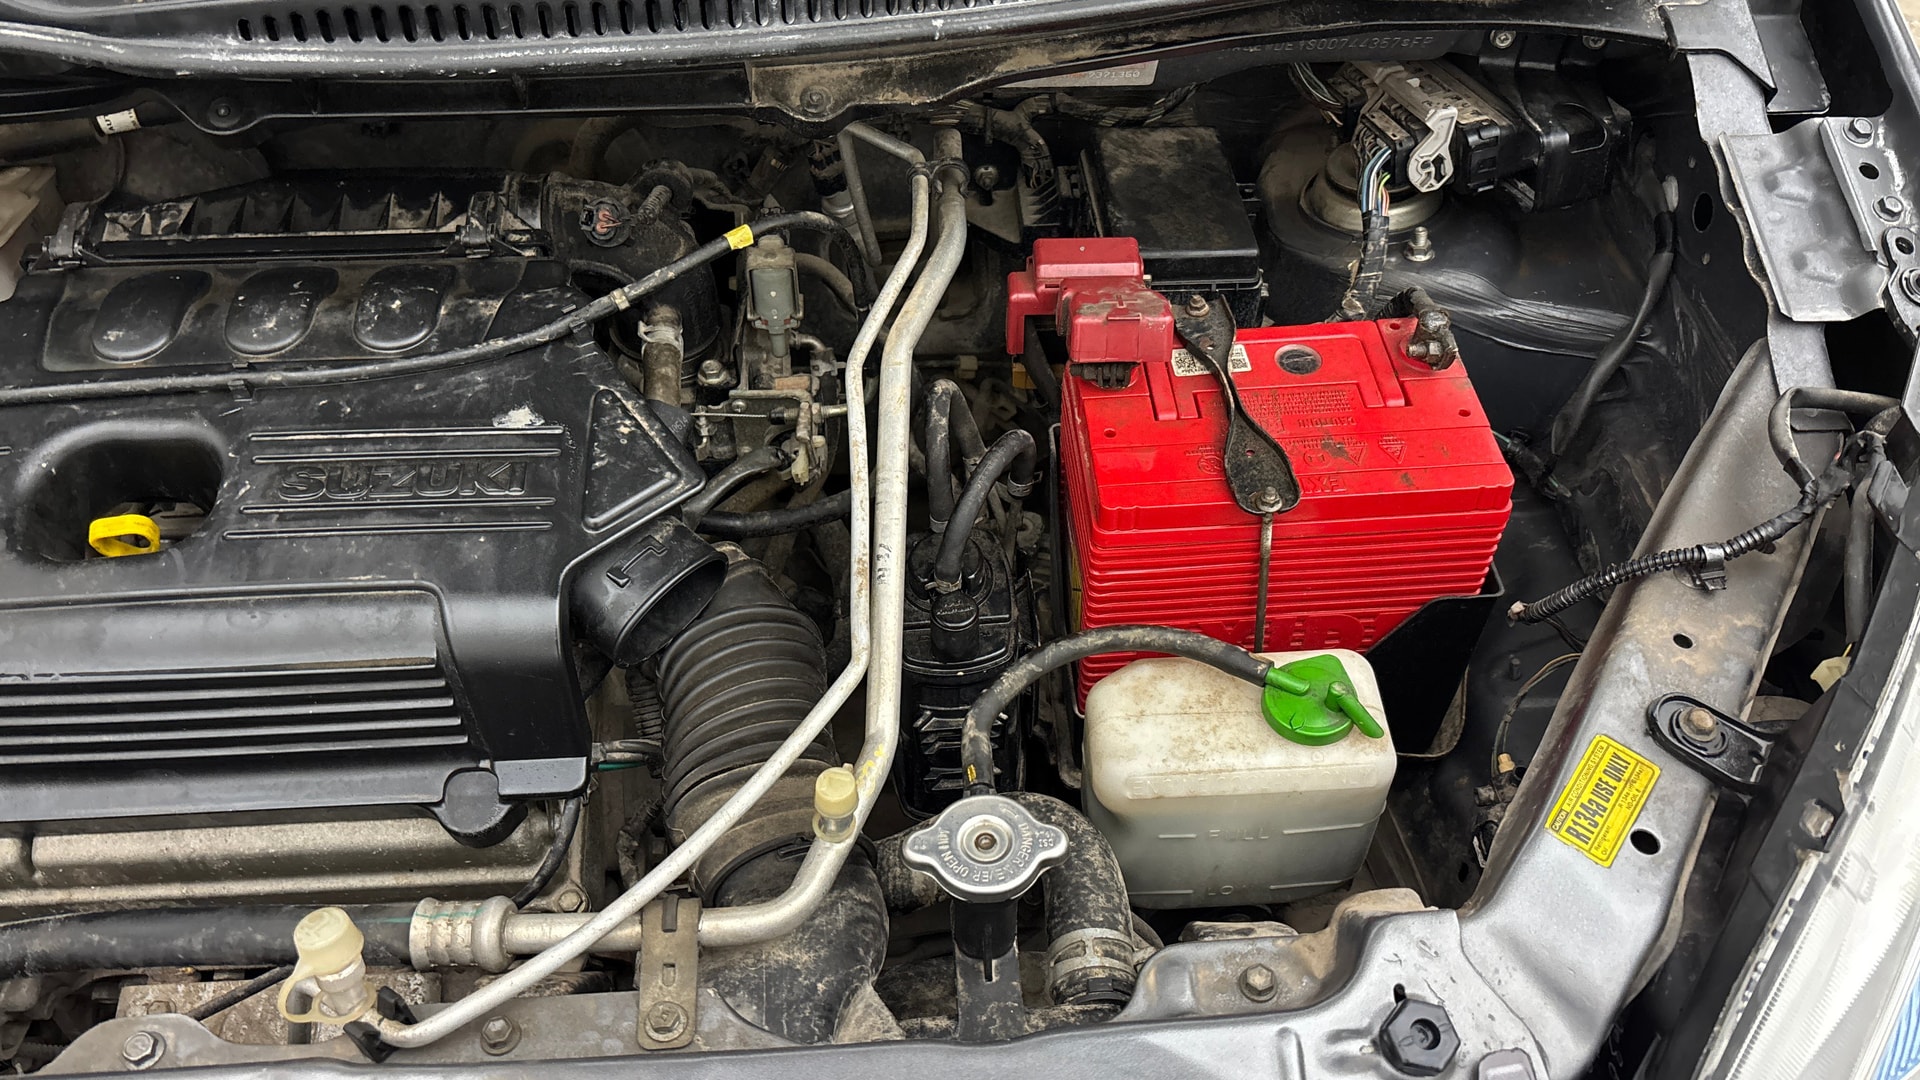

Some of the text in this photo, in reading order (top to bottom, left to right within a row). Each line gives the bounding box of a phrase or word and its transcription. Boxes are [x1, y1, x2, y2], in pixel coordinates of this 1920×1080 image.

[279, 461, 528, 500] SUZUKI
[1551, 745, 1605, 831] CAUTION AIR CONDITIONING SYSTEM
[1564, 752, 1632, 846] R134a USE ONLY
[940, 852, 970, 878] OPEN
[1012, 822, 1033, 868] DANGER
